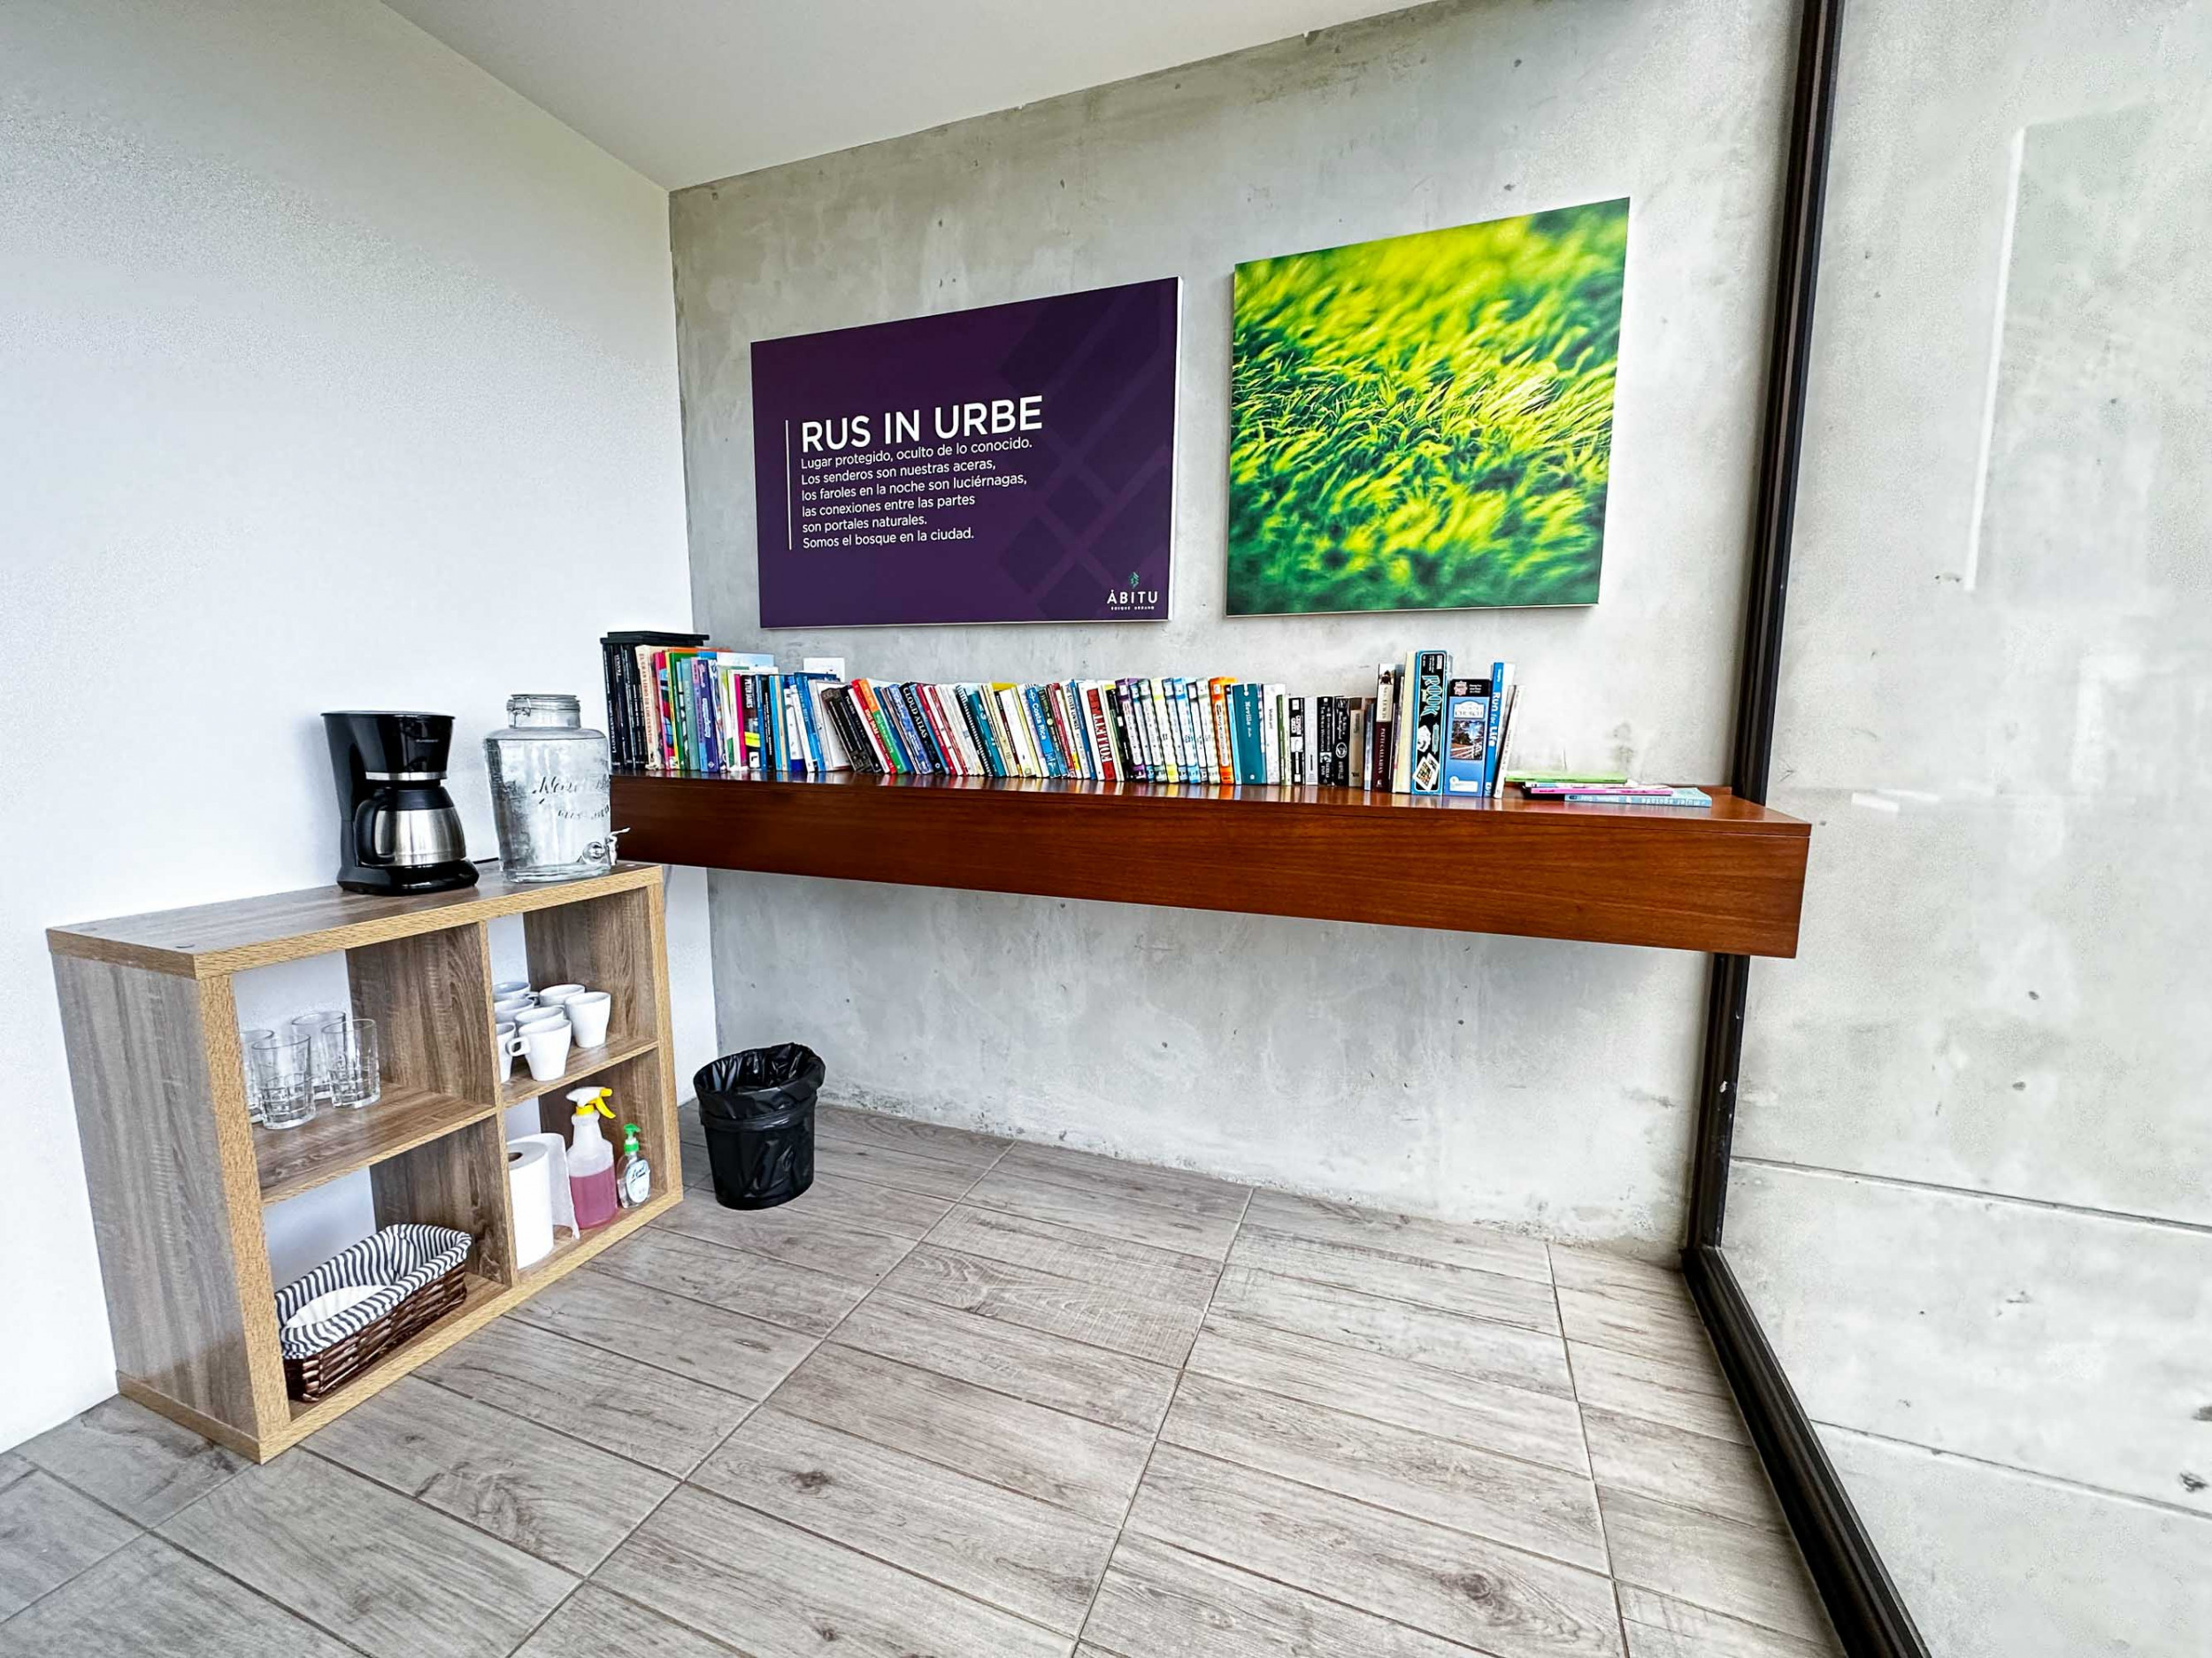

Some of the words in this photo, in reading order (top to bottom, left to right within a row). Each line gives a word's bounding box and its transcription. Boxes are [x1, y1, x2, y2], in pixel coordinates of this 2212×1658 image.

[802, 415, 871, 453] RUS
[885, 409, 920, 445] IN
[934, 395, 1042, 440] URBE
[801, 457, 833, 470] Lugar
[834, 449, 894, 468] protegido,
[895, 446, 934, 460] oculto
[936, 443, 953, 457] de
[956, 442, 968, 455] lo
[971, 436, 1033, 454] conocido.
[801, 474, 821, 486] Los
[823, 469, 873, 483] senderos
[876, 467, 897, 479] son
[900, 463, 950, 477] nuestras
[953, 459, 996, 472] aceras,
[802, 489, 818, 502] los
[819, 486, 856, 500] faroles
[859, 487, 873, 496] en
[876, 483, 887, 495] la
[889, 480, 926, 495] noche
[928, 480, 950, 491] son
[953, 474, 1027, 489] luciérnagas,
[802, 505, 817, 518] las
[818, 502, 881, 516] conexiones
[884, 498, 915, 511] entre
[918, 496, 934, 509] las
[937, 494, 976, 510] partes
[802, 523, 822, 533] son
[824, 518, 870, 533] portales
[872, 513, 927, 529] naturales.
[803, 536, 840, 549] Somos
[841, 533, 852, 547] el
[855, 533, 897, 546] bosque
[899, 533, 914, 543] en
[917, 529, 927, 541] la
[930, 526, 974, 541] ciudad.
[745, 693, 754, 709] JAMES
[1420, 674, 1443, 718] ROOK
[1490, 691, 1501, 712] Run
[902, 687, 919, 715] CLOUD
[914, 715, 929, 739] ATLAS
[1032, 702, 1043, 725] Costa
[1038, 724, 1048, 741] Rica
[1092, 712, 1113, 764] FOLLETT
[1487, 725, 1499, 748] Life
